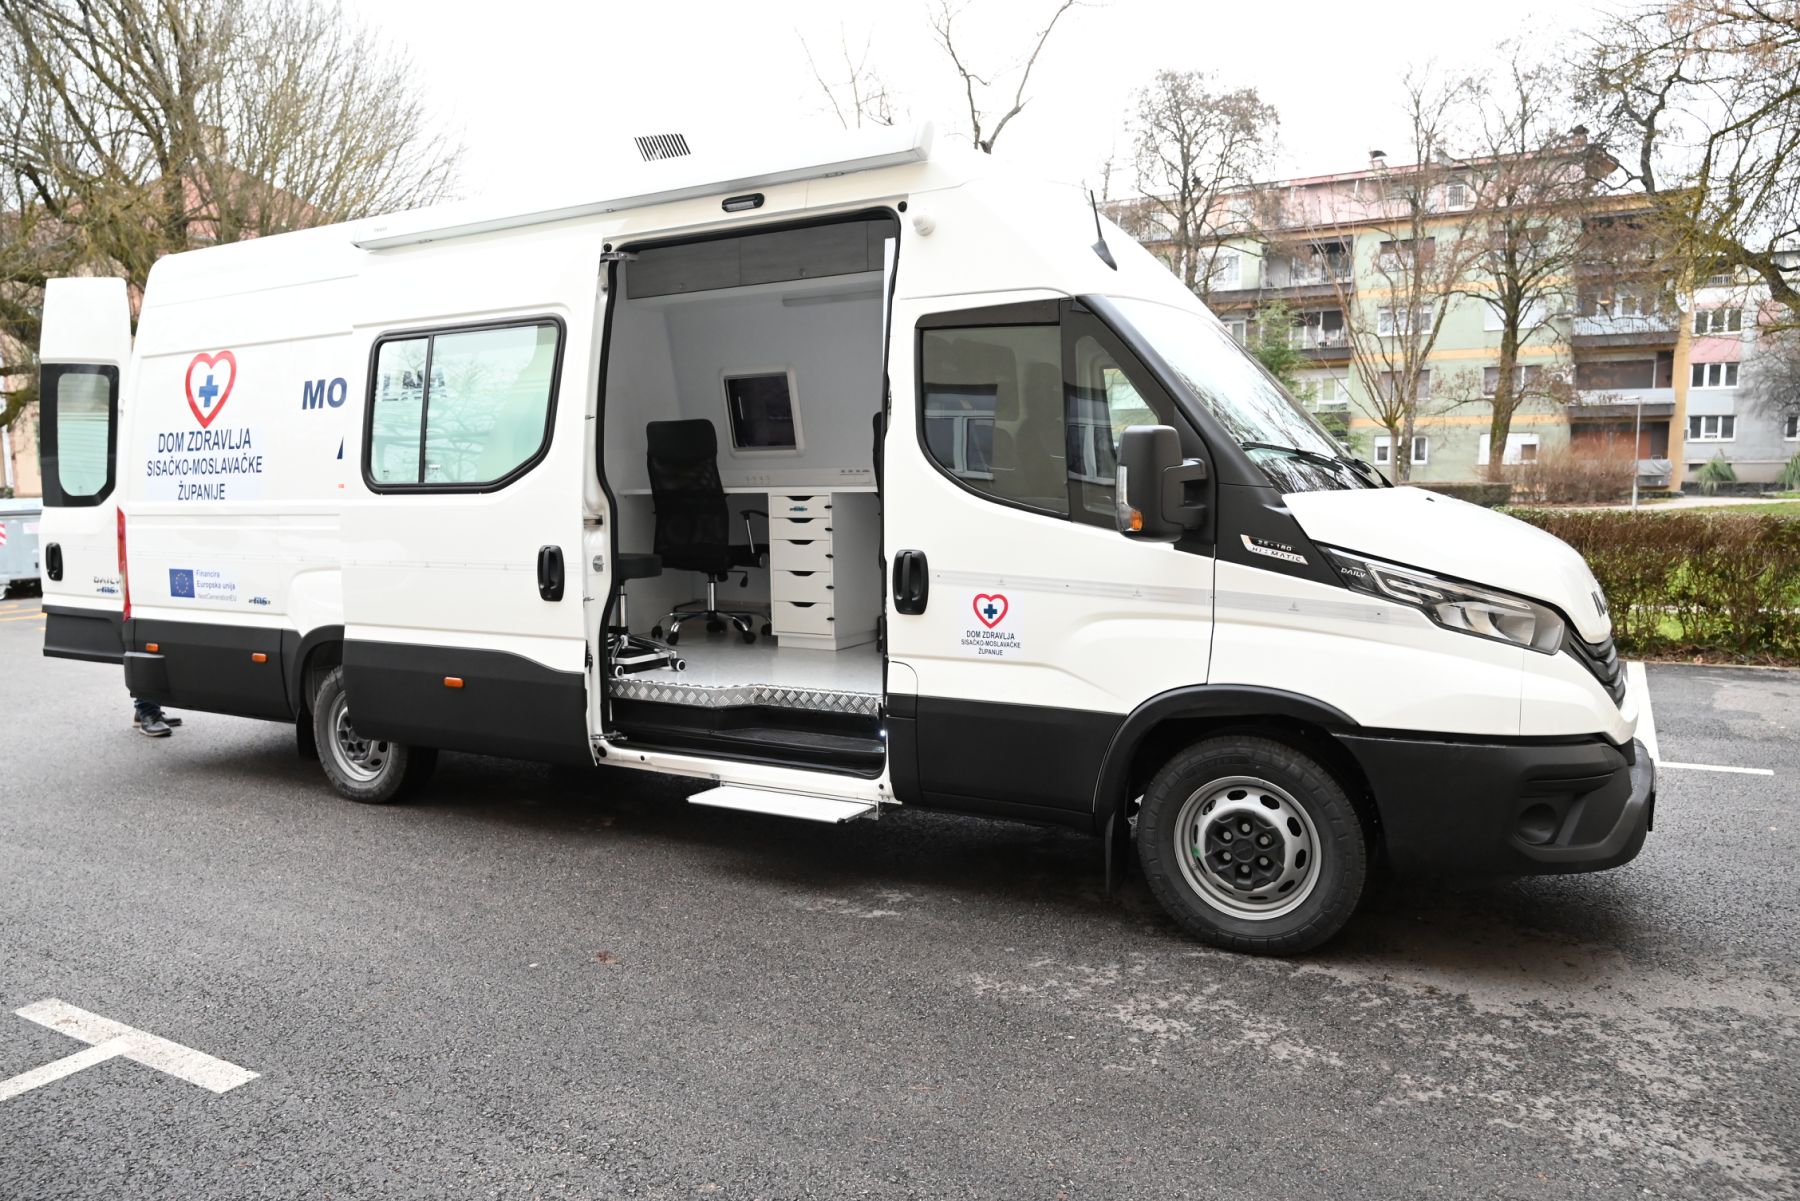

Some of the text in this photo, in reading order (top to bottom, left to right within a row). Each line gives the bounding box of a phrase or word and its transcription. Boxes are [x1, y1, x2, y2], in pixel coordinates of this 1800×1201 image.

[158, 428, 252, 454] DOM ZDRAVLJA
[146, 453, 263, 477] SISAČKO-MOSLAVAČKE
[177, 481, 226, 501] ŽUPANIJE
[196, 569, 220, 578] Financira
[1340, 567, 1366, 578] DAILY
[197, 580, 236, 591] Europska unija
[966, 630, 1015, 639] DOM ZDRAVLJA
[961, 639, 1021, 648] SISAČKO-MOSLAVAČKE
